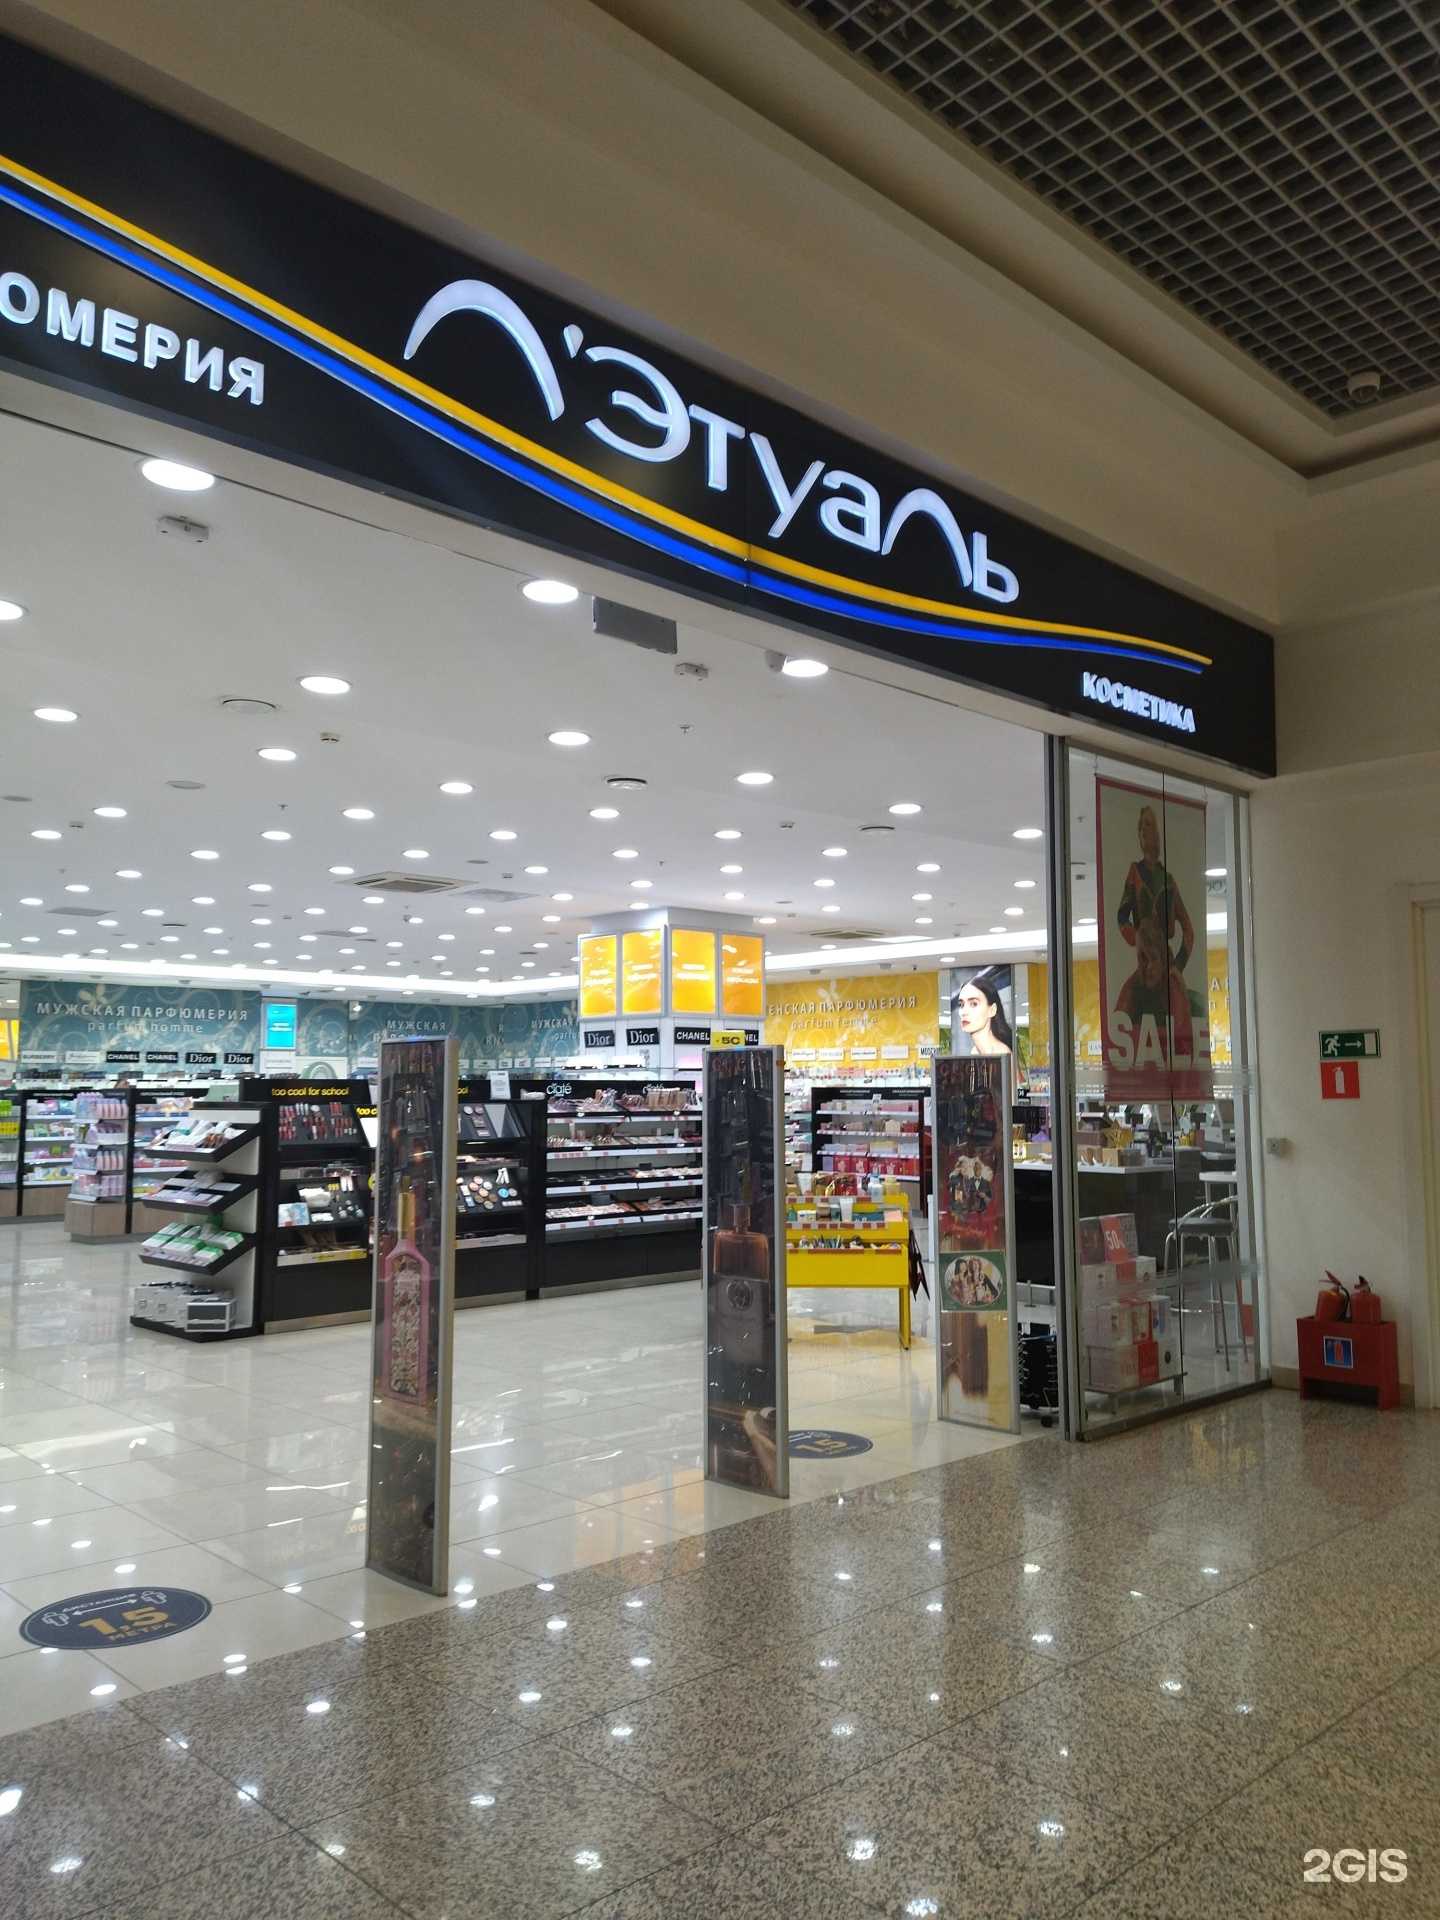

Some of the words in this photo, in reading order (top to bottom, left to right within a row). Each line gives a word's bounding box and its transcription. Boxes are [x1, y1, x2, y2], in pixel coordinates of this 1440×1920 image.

[1083, 671, 1196, 733] КОСМЕТИКА
[819, 996, 917, 1012] ПАРФЮМЕРИЯ
[36, 1002, 126, 1017] МУЖСКАЯ
[131, 1006, 248, 1021] ПАРФЮМЕРИЯ
[151, 1023, 203, 1034] homme
[386, 1019, 447, 1031] МУЖСКАЯ
[588, 1031, 612, 1047] Dior
[629, 1027, 655, 1044] Dior
[676, 1030, 710, 1042] CHANEL
[1107, 1010, 1212, 1071] SALE
[107, 1053, 139, 1061] CHANEL
[147, 1053, 177, 1061] CHANEL
[189, 1053, 215, 1063] Dior
[227, 1053, 252, 1063] Dior
[271, 1087, 286, 1096] too
[287, 1086, 306, 1096] cool
[308, 1086, 320, 1096] for
[321, 1086, 349, 1096] school
